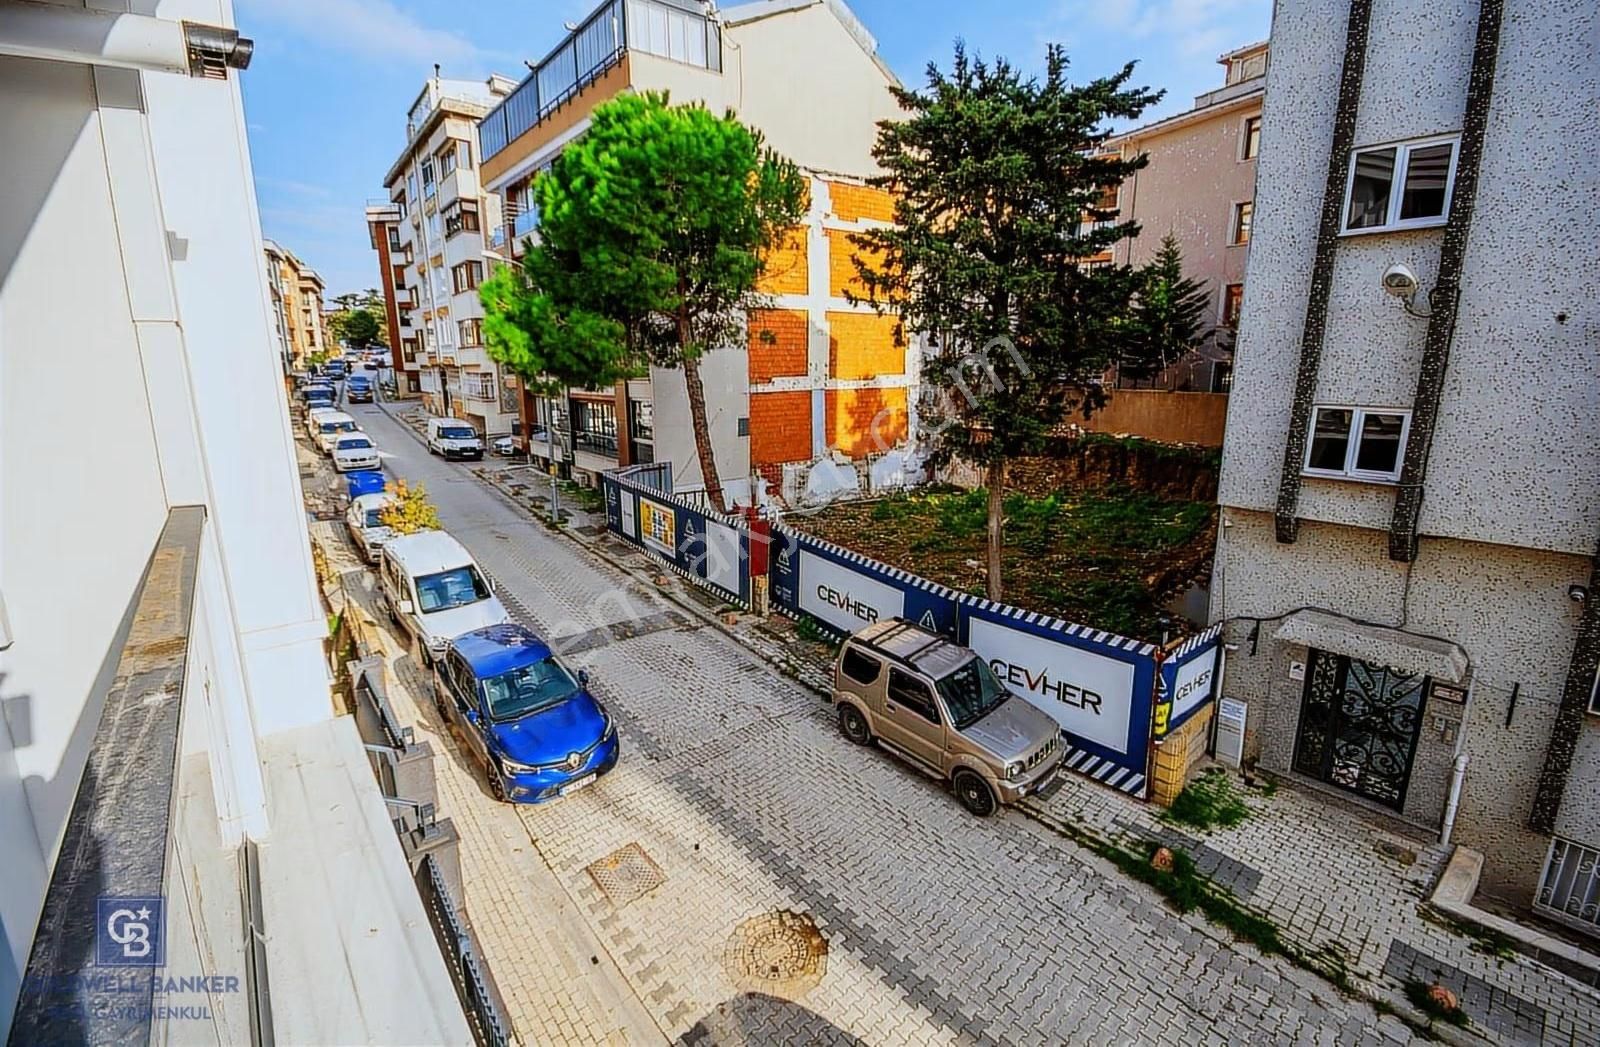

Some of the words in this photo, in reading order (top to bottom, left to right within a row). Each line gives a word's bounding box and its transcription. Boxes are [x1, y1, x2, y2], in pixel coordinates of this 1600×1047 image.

[817, 583, 879, 625] CEVHER
[989, 658, 1103, 716] CEVHER
[1175, 669, 1212, 701] CEVHER
